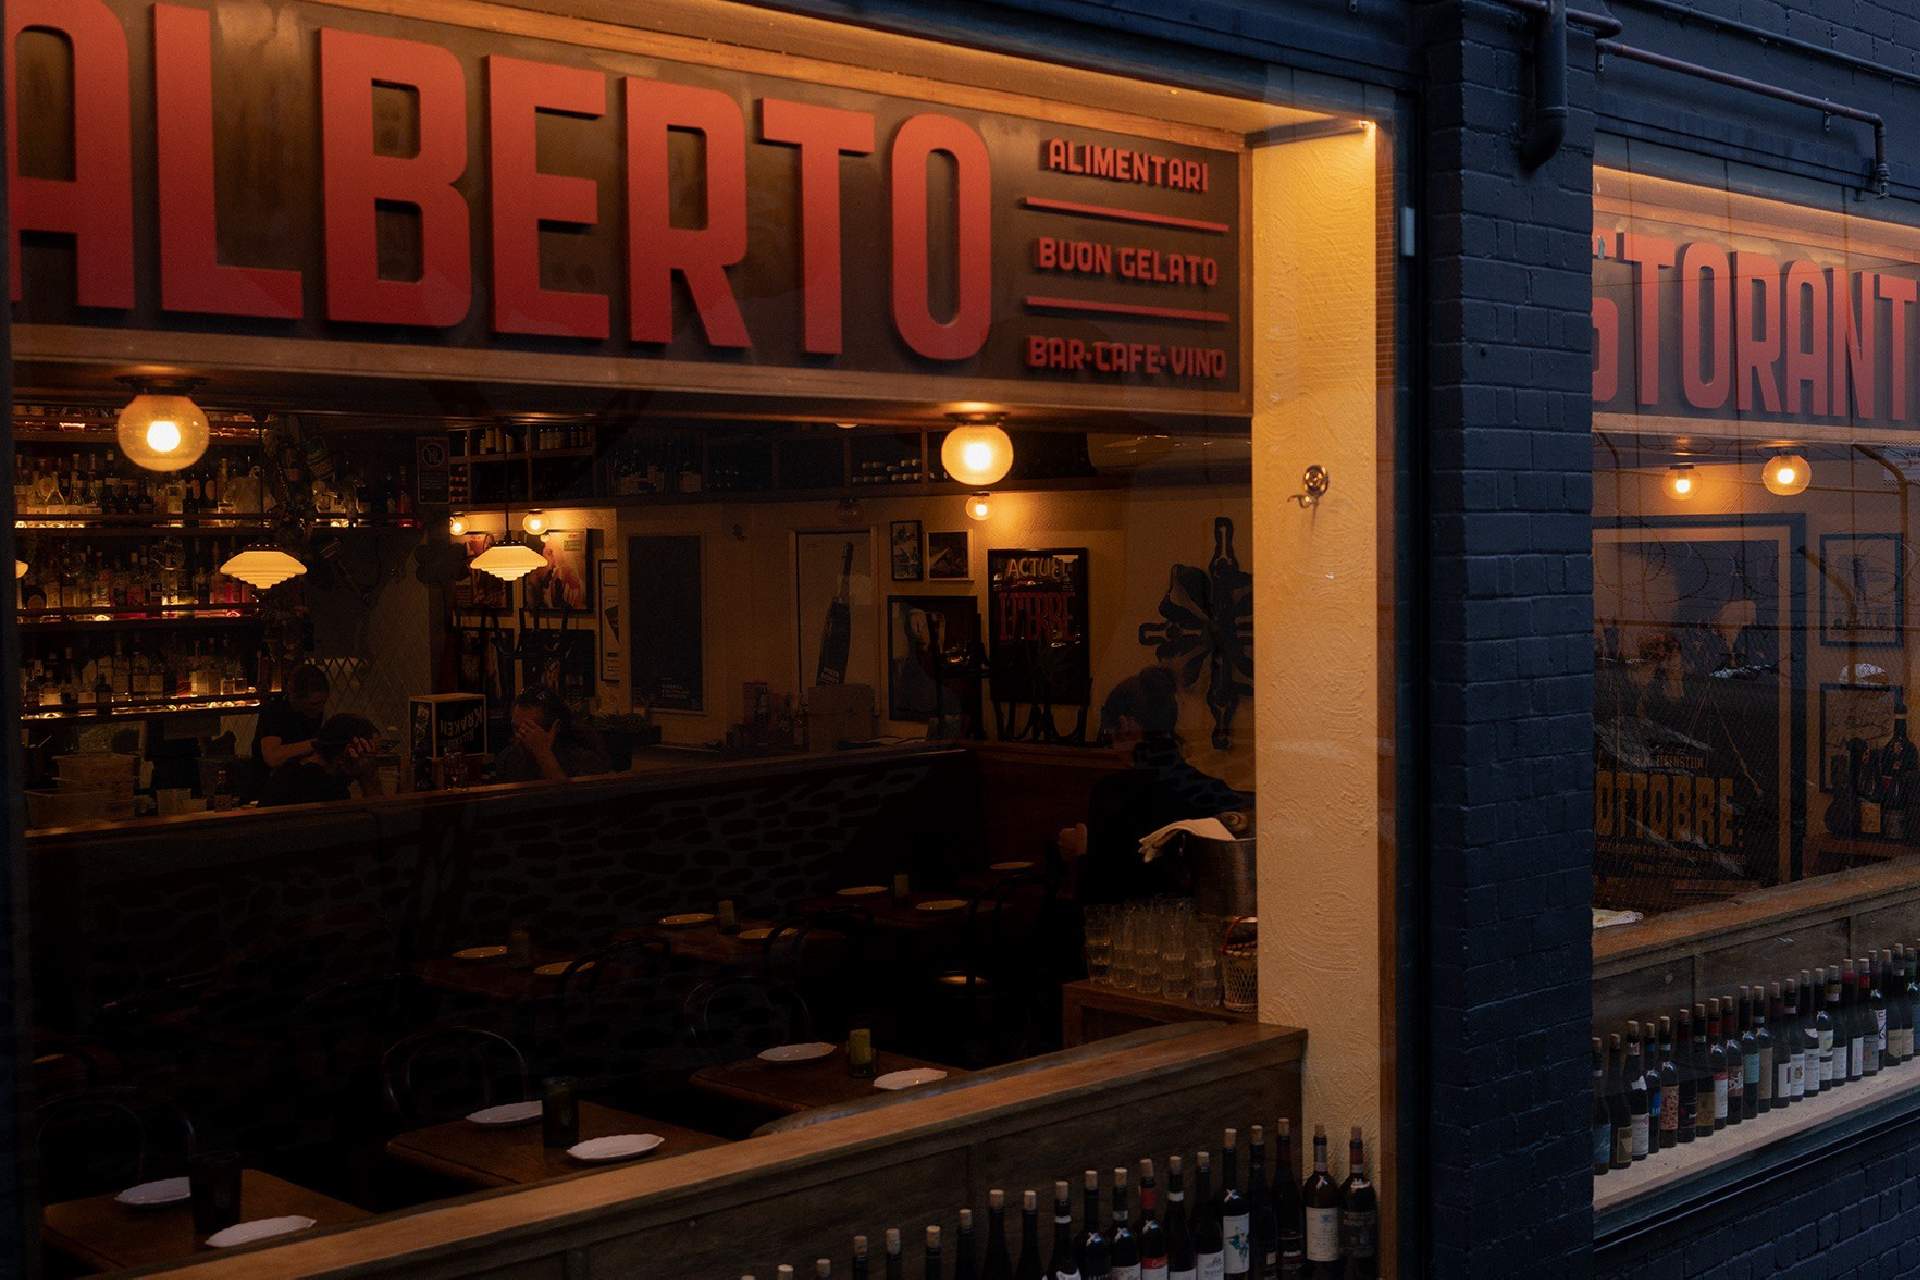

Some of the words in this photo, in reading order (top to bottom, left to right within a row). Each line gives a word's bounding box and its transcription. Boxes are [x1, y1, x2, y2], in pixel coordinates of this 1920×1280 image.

[8, 0, 993, 362] ALBERTO
[1048, 137, 1210, 193] ALIMENTARI
[1038, 236, 1112, 274] BUON
[1118, 248, 1218, 287] GELATO
